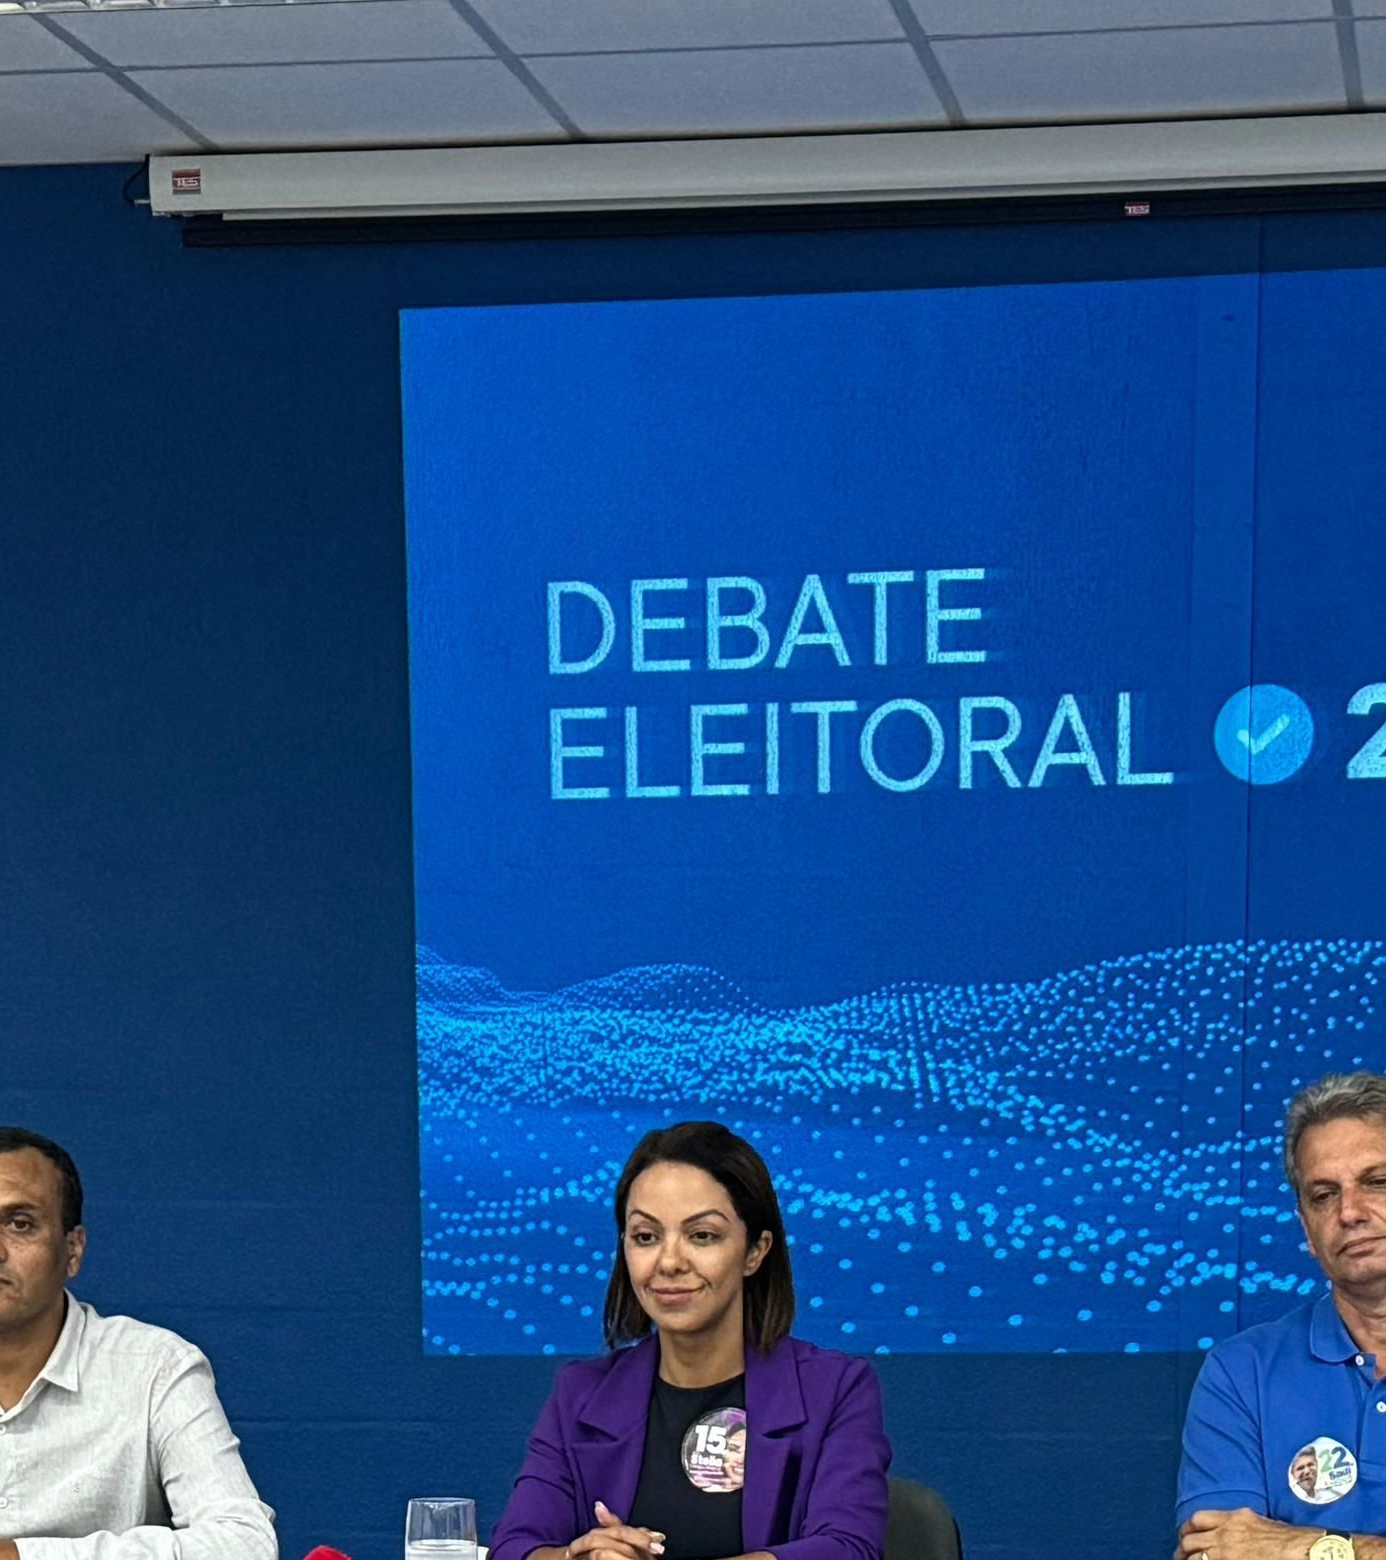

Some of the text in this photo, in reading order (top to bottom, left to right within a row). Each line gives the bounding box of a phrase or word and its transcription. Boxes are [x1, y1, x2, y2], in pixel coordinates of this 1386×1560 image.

[546, 568, 987, 674] DEBATE
[549, 692, 1175, 800] ELEITORAL
[695, 1424, 727, 1455] 15
[1318, 1446, 1351, 1473] 22
